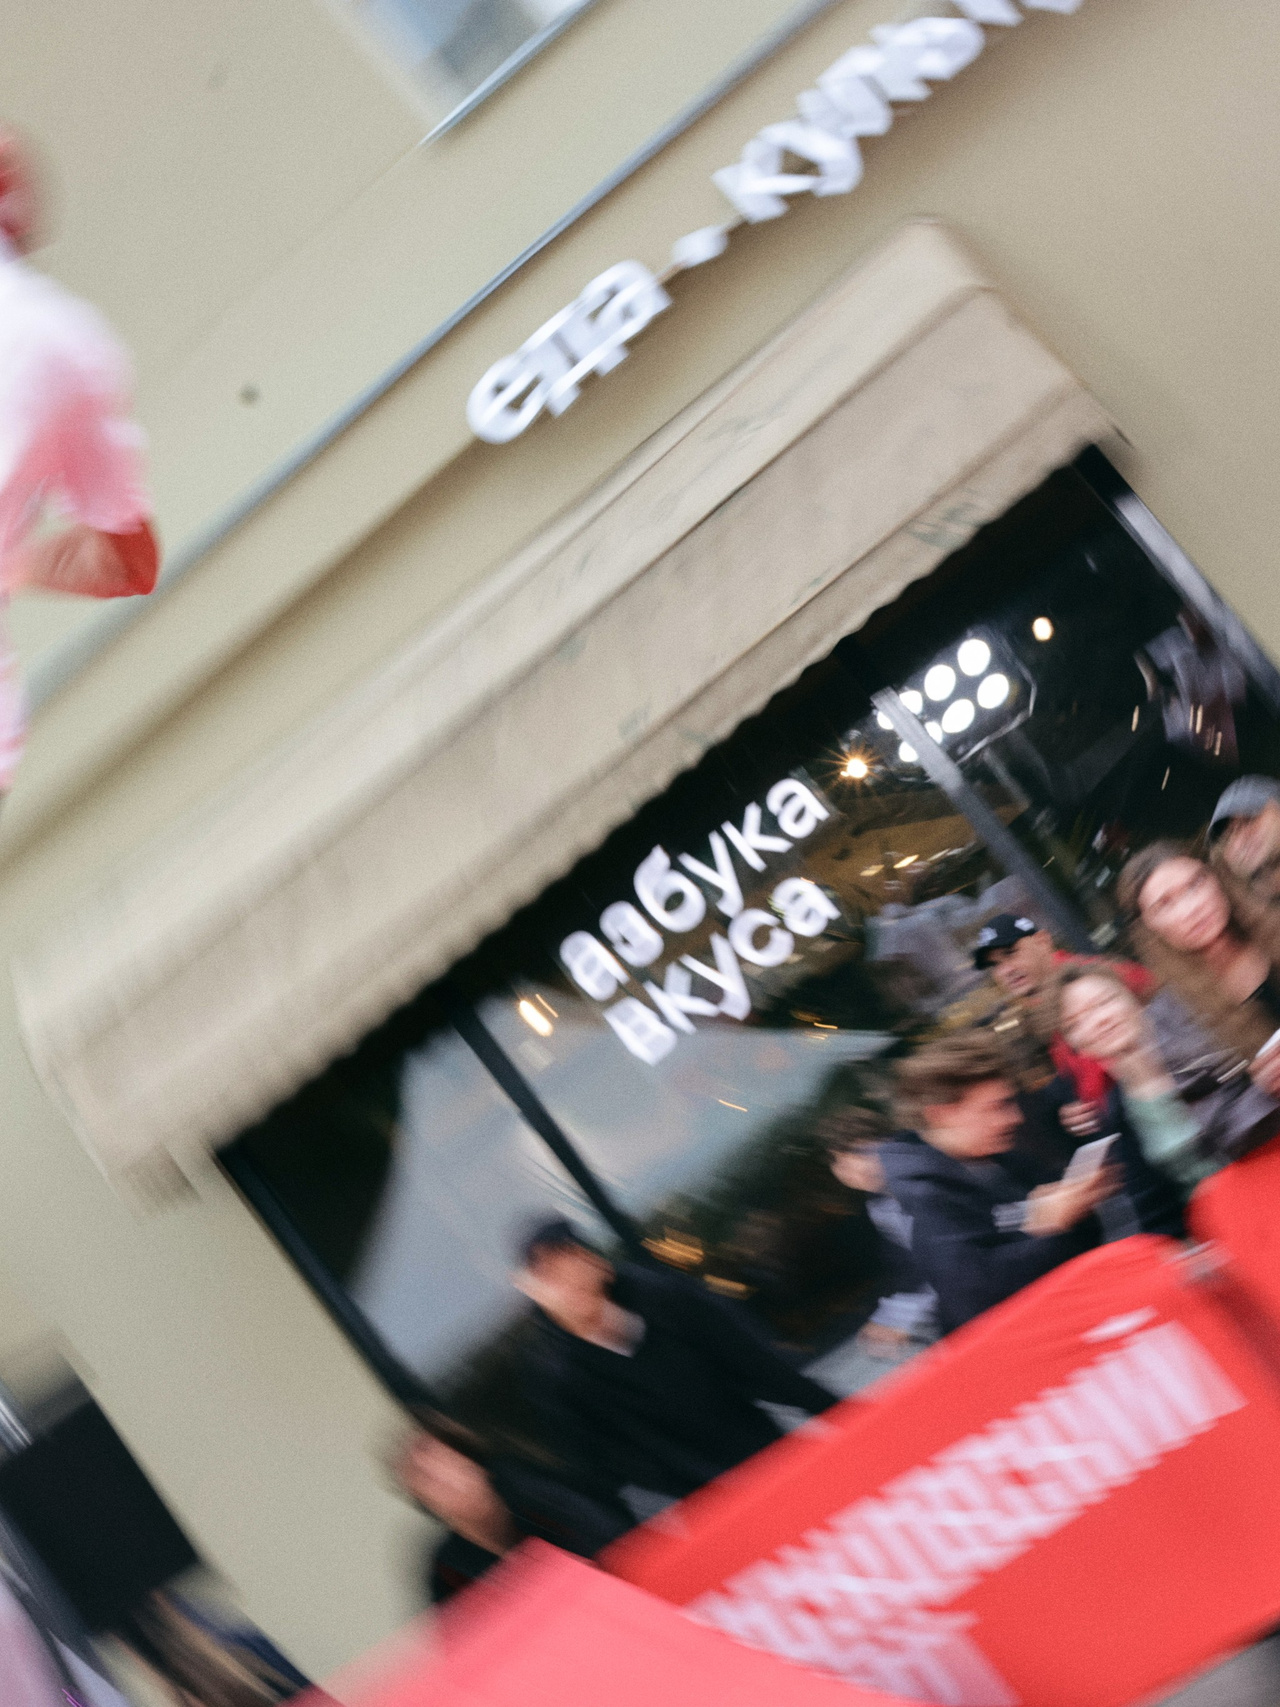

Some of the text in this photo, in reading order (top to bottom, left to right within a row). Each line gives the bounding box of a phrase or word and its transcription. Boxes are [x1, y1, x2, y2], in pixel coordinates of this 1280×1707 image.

[467, 260, 673, 443] еда
[558, 777, 831, 1002] азбука
[602, 876, 842, 1067] вкуса
